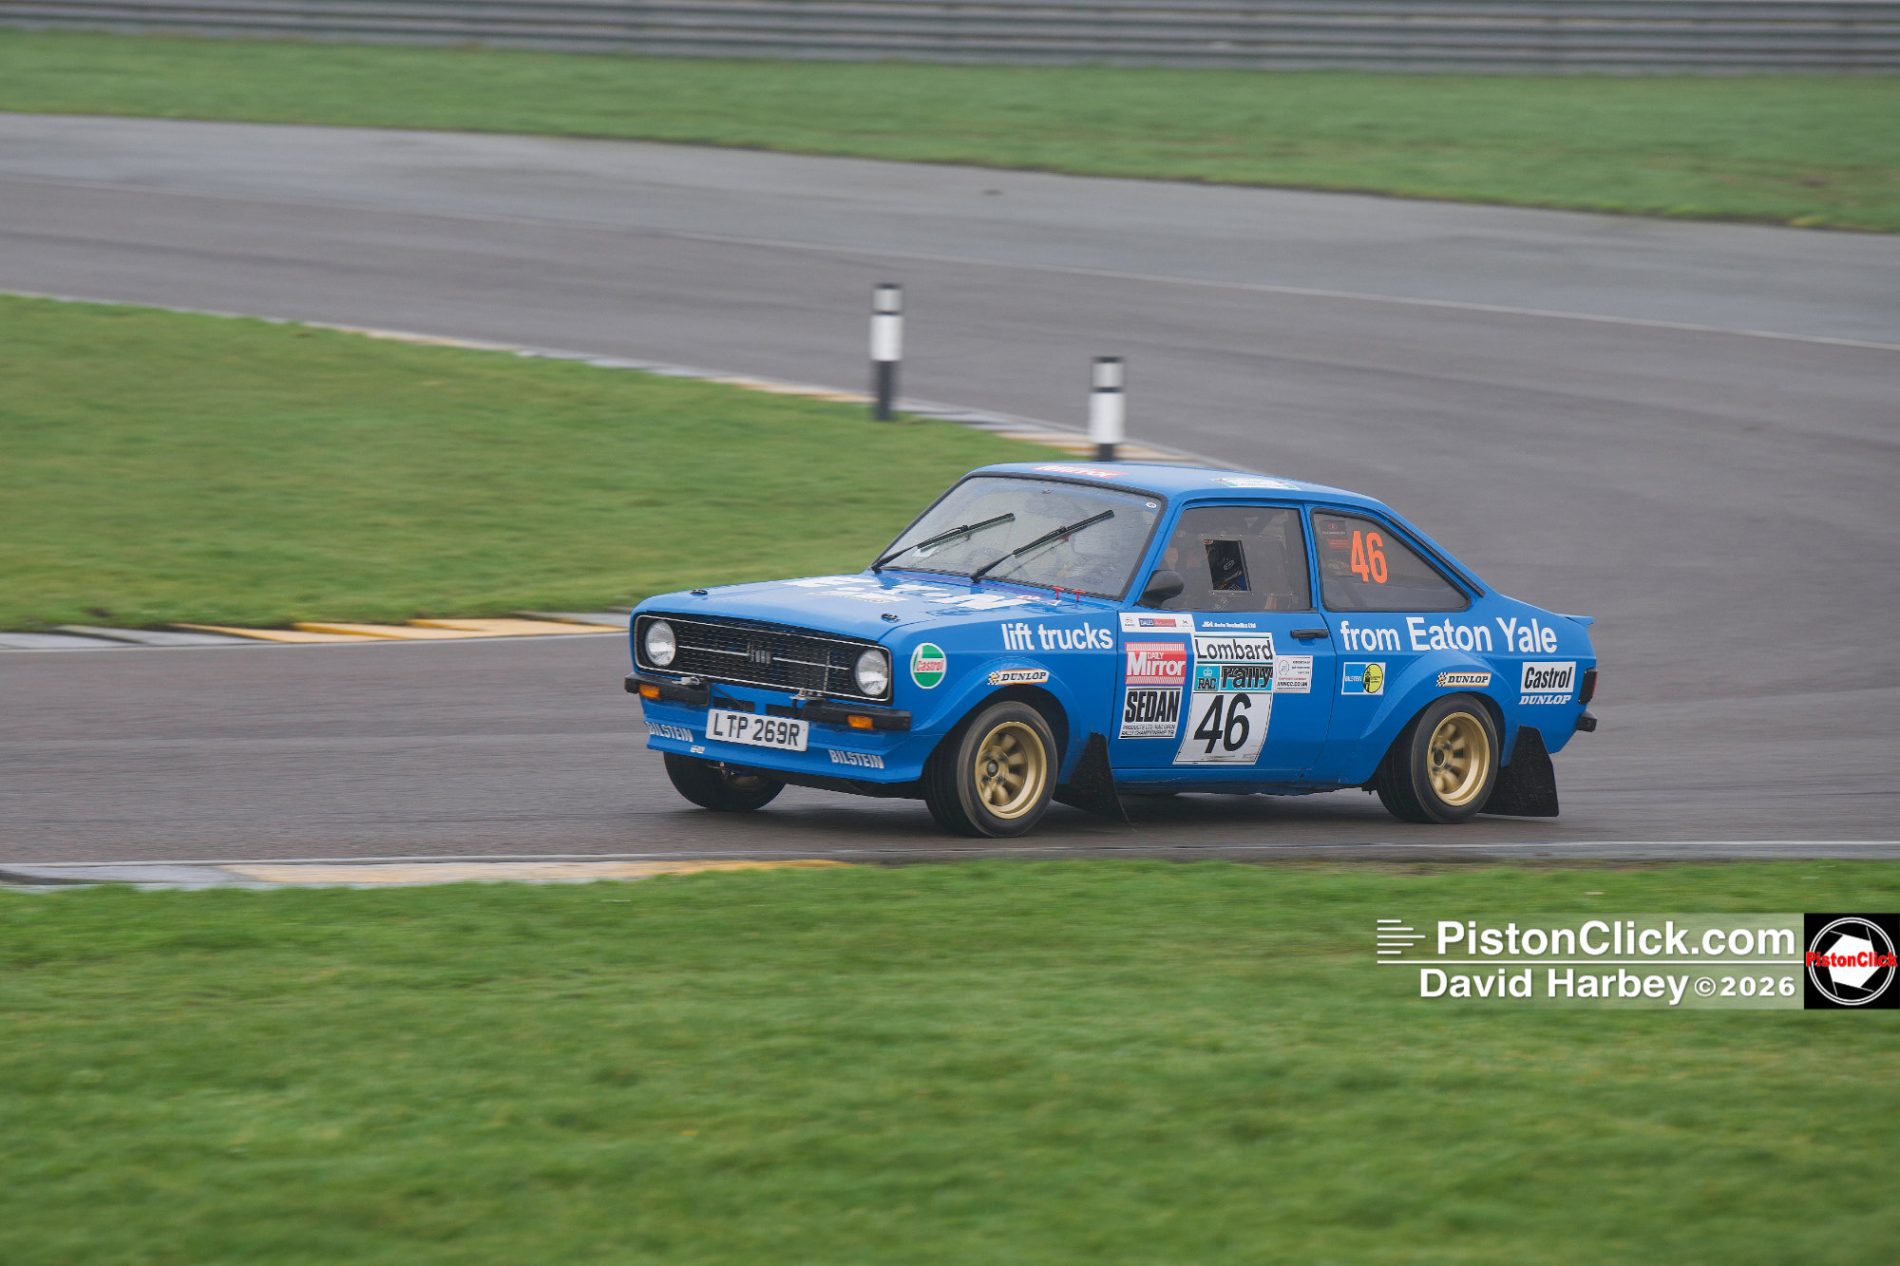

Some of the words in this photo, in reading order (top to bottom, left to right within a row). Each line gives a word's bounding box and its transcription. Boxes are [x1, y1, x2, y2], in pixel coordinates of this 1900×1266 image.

[1351, 531, 1388, 583] 46
[1001, 622, 1035, 650] lift
[1038, 622, 1114, 650] trucks
[1340, 620, 1401, 651] from
[1406, 616, 1493, 651] Eaton
[1496, 617, 1558, 653] Yale
[1195, 639, 1273, 660] Lombard
[916, 660, 944, 671] Castrol
[1126, 651, 1186, 676] Mirror
[1001, 671, 1047, 682] DUNLOP
[1198, 677, 1216, 689] RAC
[1222, 666, 1273, 689] rally
[1447, 675, 1489, 683] DUNLOP
[1524, 666, 1573, 689] Castrol
[1124, 691, 1181, 722] SEDAN
[1519, 695, 1572, 705] DUNLOP
[644, 721, 694, 742] BILSTEIN
[714, 712, 748, 739] LTP
[753, 718, 800, 747] 269R
[1194, 692, 1252, 754] 46
[829, 749, 885, 769] BILSTEIN
